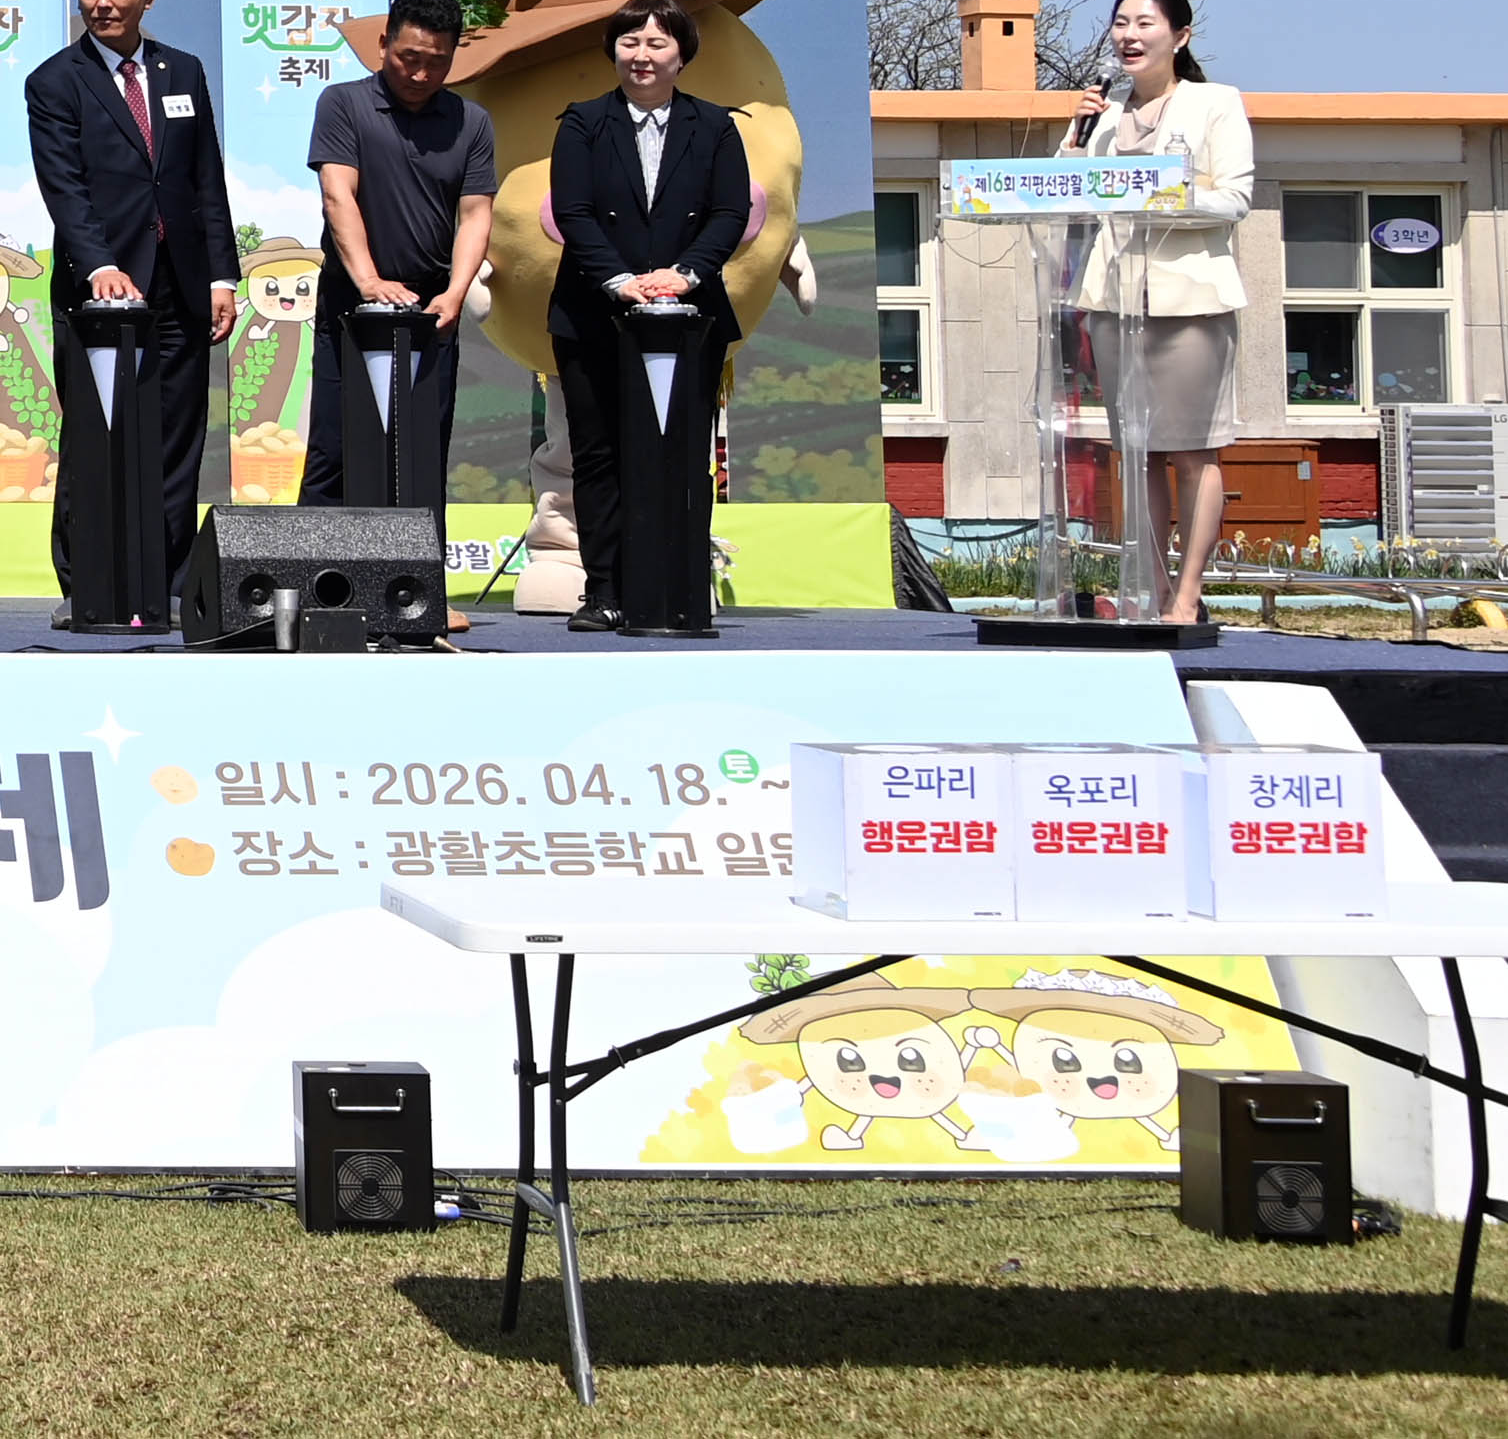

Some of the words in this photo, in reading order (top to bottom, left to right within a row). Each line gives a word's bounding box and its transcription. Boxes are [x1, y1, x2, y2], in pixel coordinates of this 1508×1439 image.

[279, 56, 330, 87] 축제
[975, 171, 1015, 193] 제16회
[1020, 173, 1082, 196] 지평선광활
[1087, 169, 1159, 198] 햇감자축제
[1494, 414, 1508, 423] LG
[215, 761, 317, 806] 일시
[368, 762, 527, 806] 2026.
[543, 762, 632, 806] 04.
[883, 766, 975, 799] 은파리
[1044, 774, 1137, 808] 옥포리
[1249, 775, 1342, 808] 창제리
[861, 820, 998, 853] 행운권함
[1031, 821, 1169, 854] 행운권함
[1229, 821, 1368, 854] 행운권함
[231, 830, 340, 876] 장소
[385, 830, 704, 877] 광활초등학교
